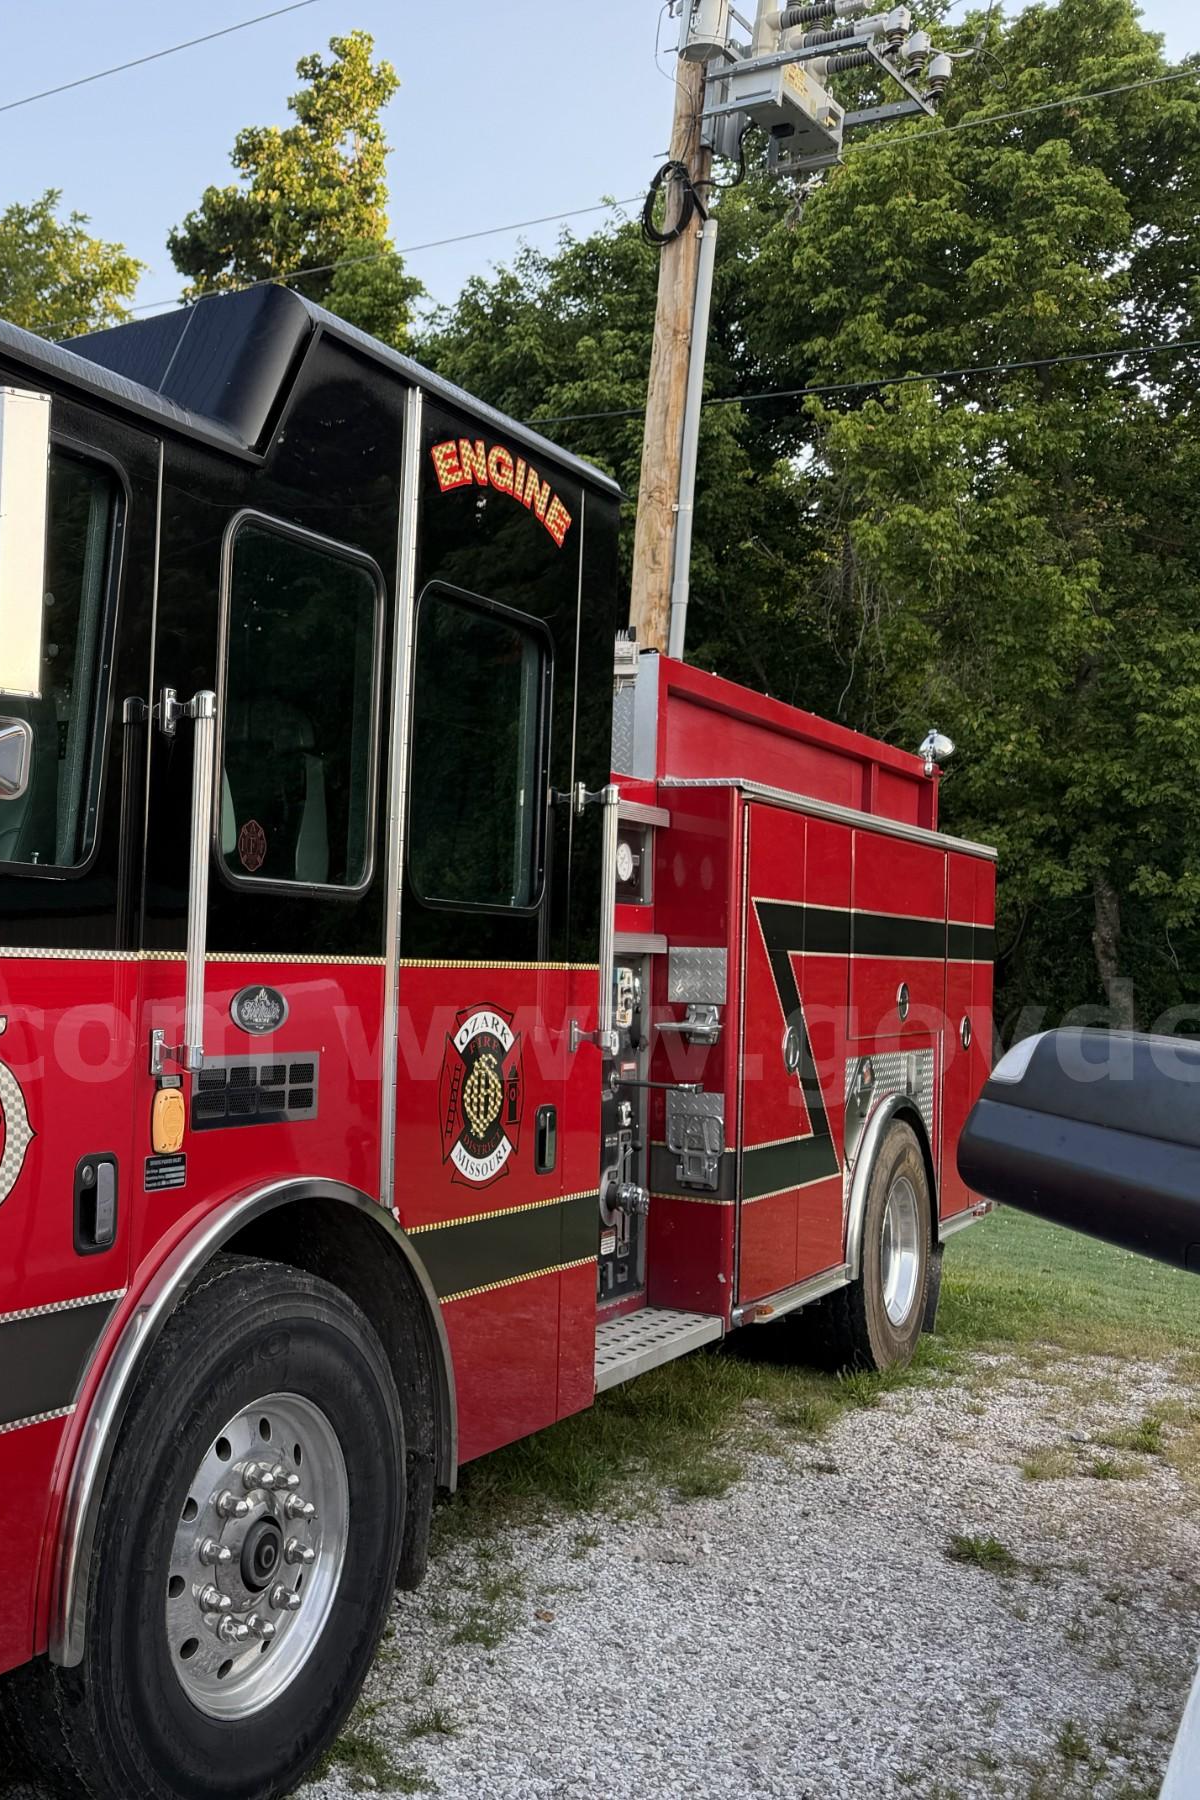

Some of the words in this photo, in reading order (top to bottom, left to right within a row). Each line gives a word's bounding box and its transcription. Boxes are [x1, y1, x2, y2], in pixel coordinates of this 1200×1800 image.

[431, 438, 573, 548] ENGINE
[458, 1015, 510, 1048] OZARK
[469, 1035, 501, 1055] FIRE
[463, 1130, 501, 1155] DISTRICT
[455, 1143, 508, 1178] MISSOURI
